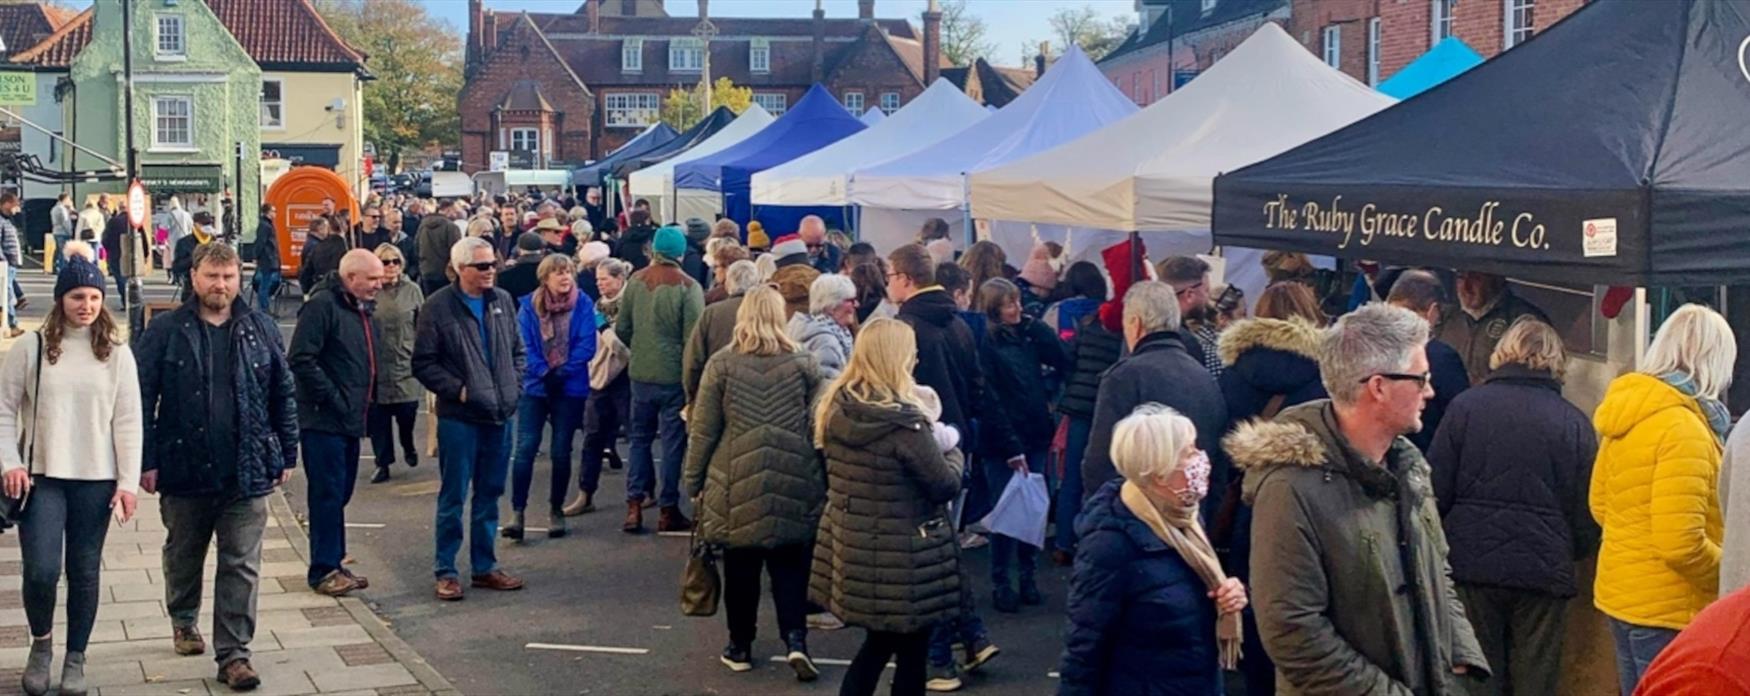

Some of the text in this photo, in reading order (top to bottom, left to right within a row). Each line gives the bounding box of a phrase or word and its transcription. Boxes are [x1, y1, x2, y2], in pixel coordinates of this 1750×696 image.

[0, 75, 25, 83] SON
[1263, 193, 1550, 250] The Ruby Grace Candle Co.
